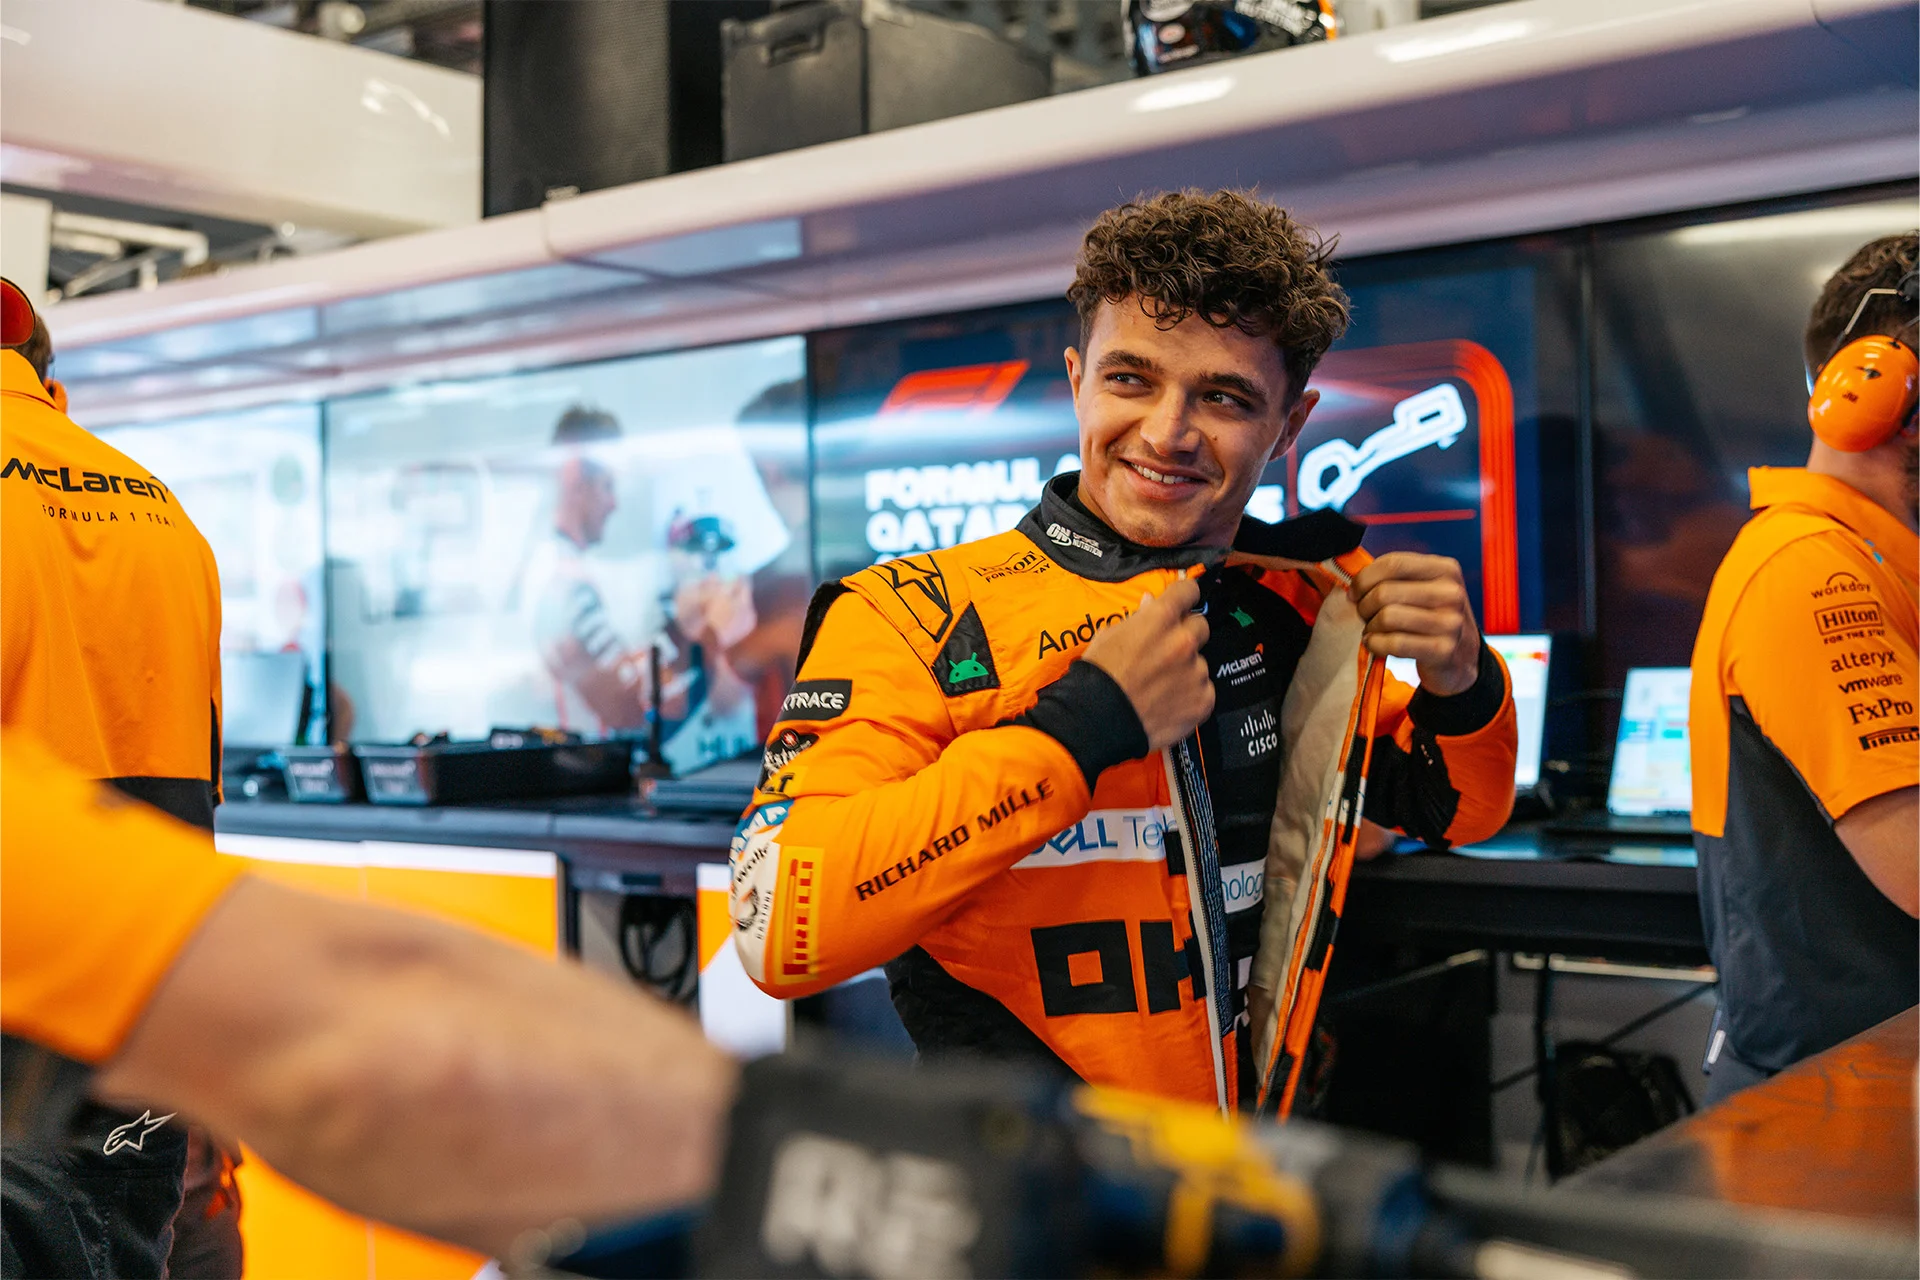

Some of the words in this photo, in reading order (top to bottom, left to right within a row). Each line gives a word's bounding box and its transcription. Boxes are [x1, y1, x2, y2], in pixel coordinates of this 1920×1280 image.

[1, 458, 167, 503] McLaren
[42, 504, 118, 522] FORMULA
[130, 511, 136, 522] 1
[147, 512, 176, 528] TEA
[1811, 582, 1870, 599] workday
[1822, 610, 1879, 628] Hilton
[1824, 635, 1843, 645] FOR
[1216, 648, 1264, 678] McLaren
[1831, 651, 1896, 673] alteryx
[1838, 674, 1903, 694] vmware
[1848, 698, 1913, 725] FxPro
[1248, 733, 1278, 757] CISCO
[855, 824, 970, 901] RICHARD
[977, 778, 1054, 832] MILLE
[782, 858, 814, 976] PIRELLI
